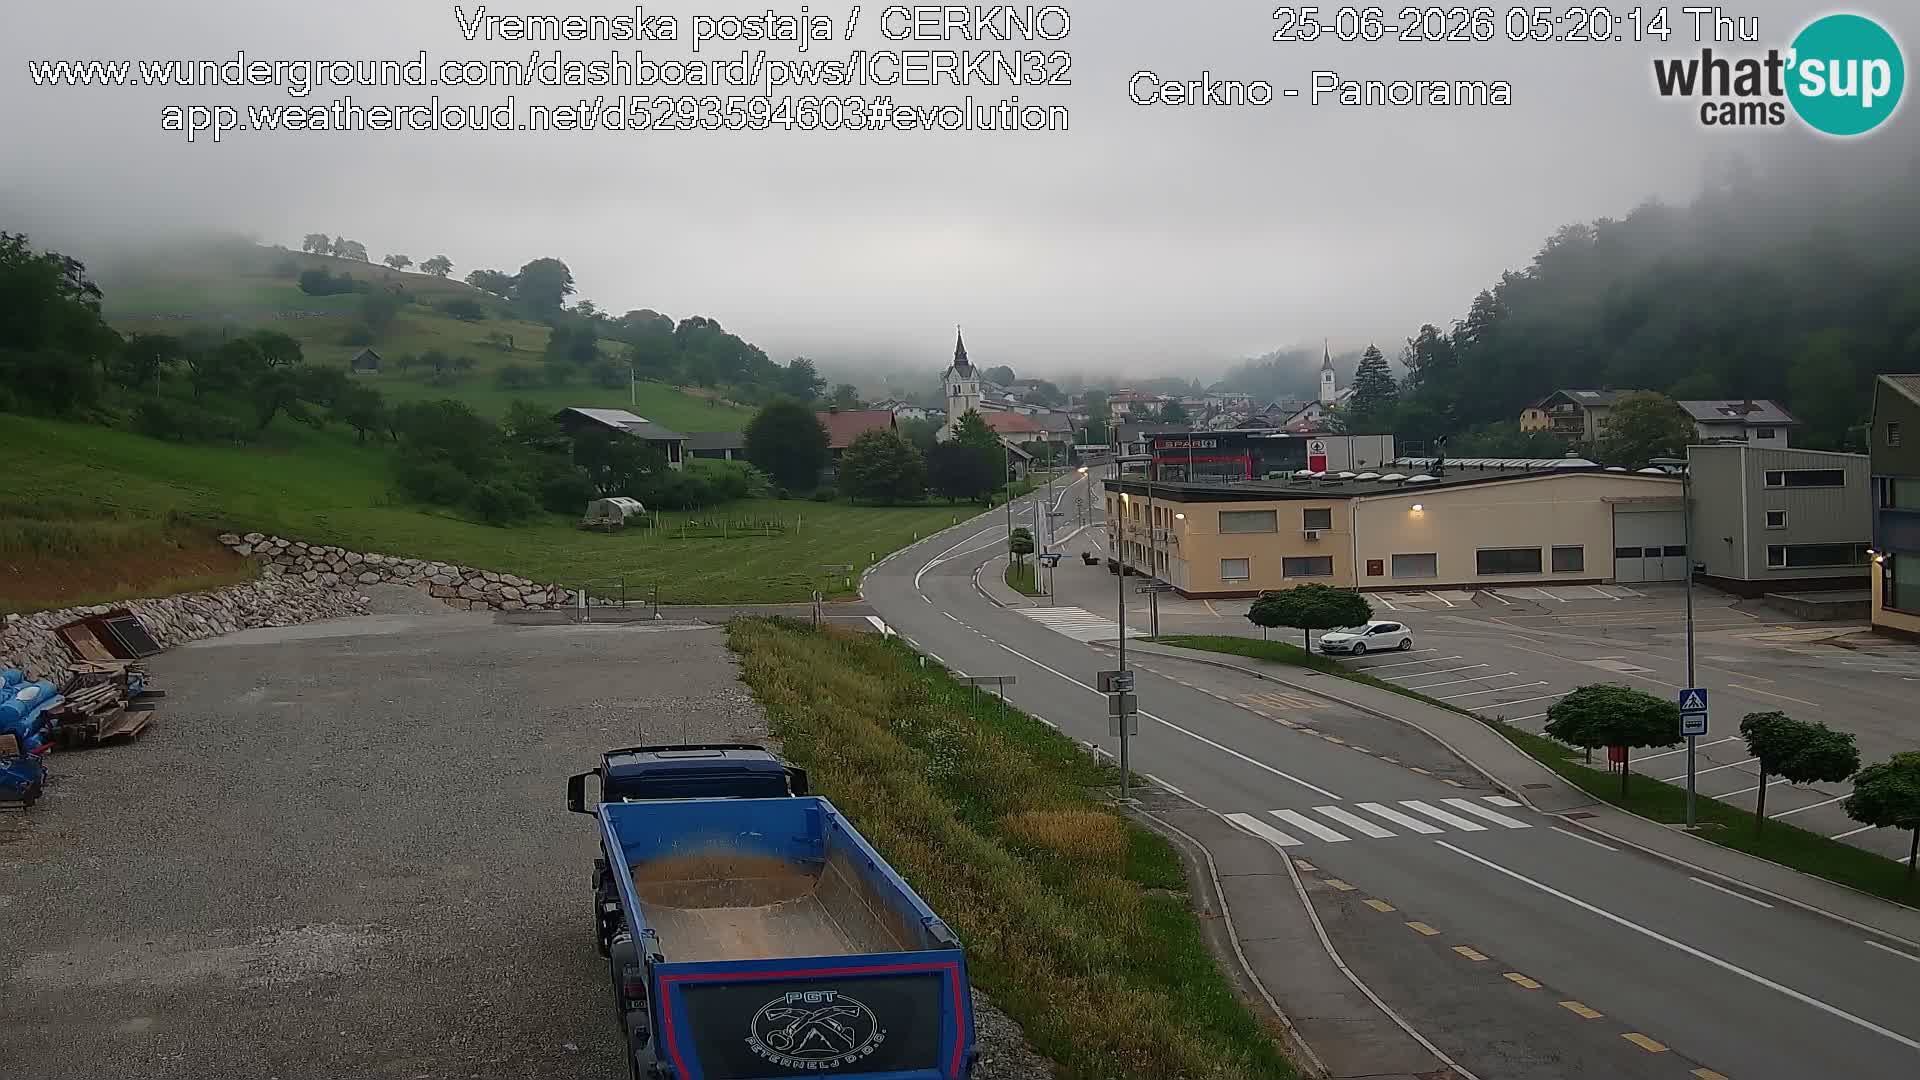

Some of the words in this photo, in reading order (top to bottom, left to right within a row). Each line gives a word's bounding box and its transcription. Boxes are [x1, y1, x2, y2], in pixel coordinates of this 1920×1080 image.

[1165, 440, 1202, 448] SPAR
[785, 988, 838, 1005] PGT
[744, 1036, 840, 1070] PETERNELJ
